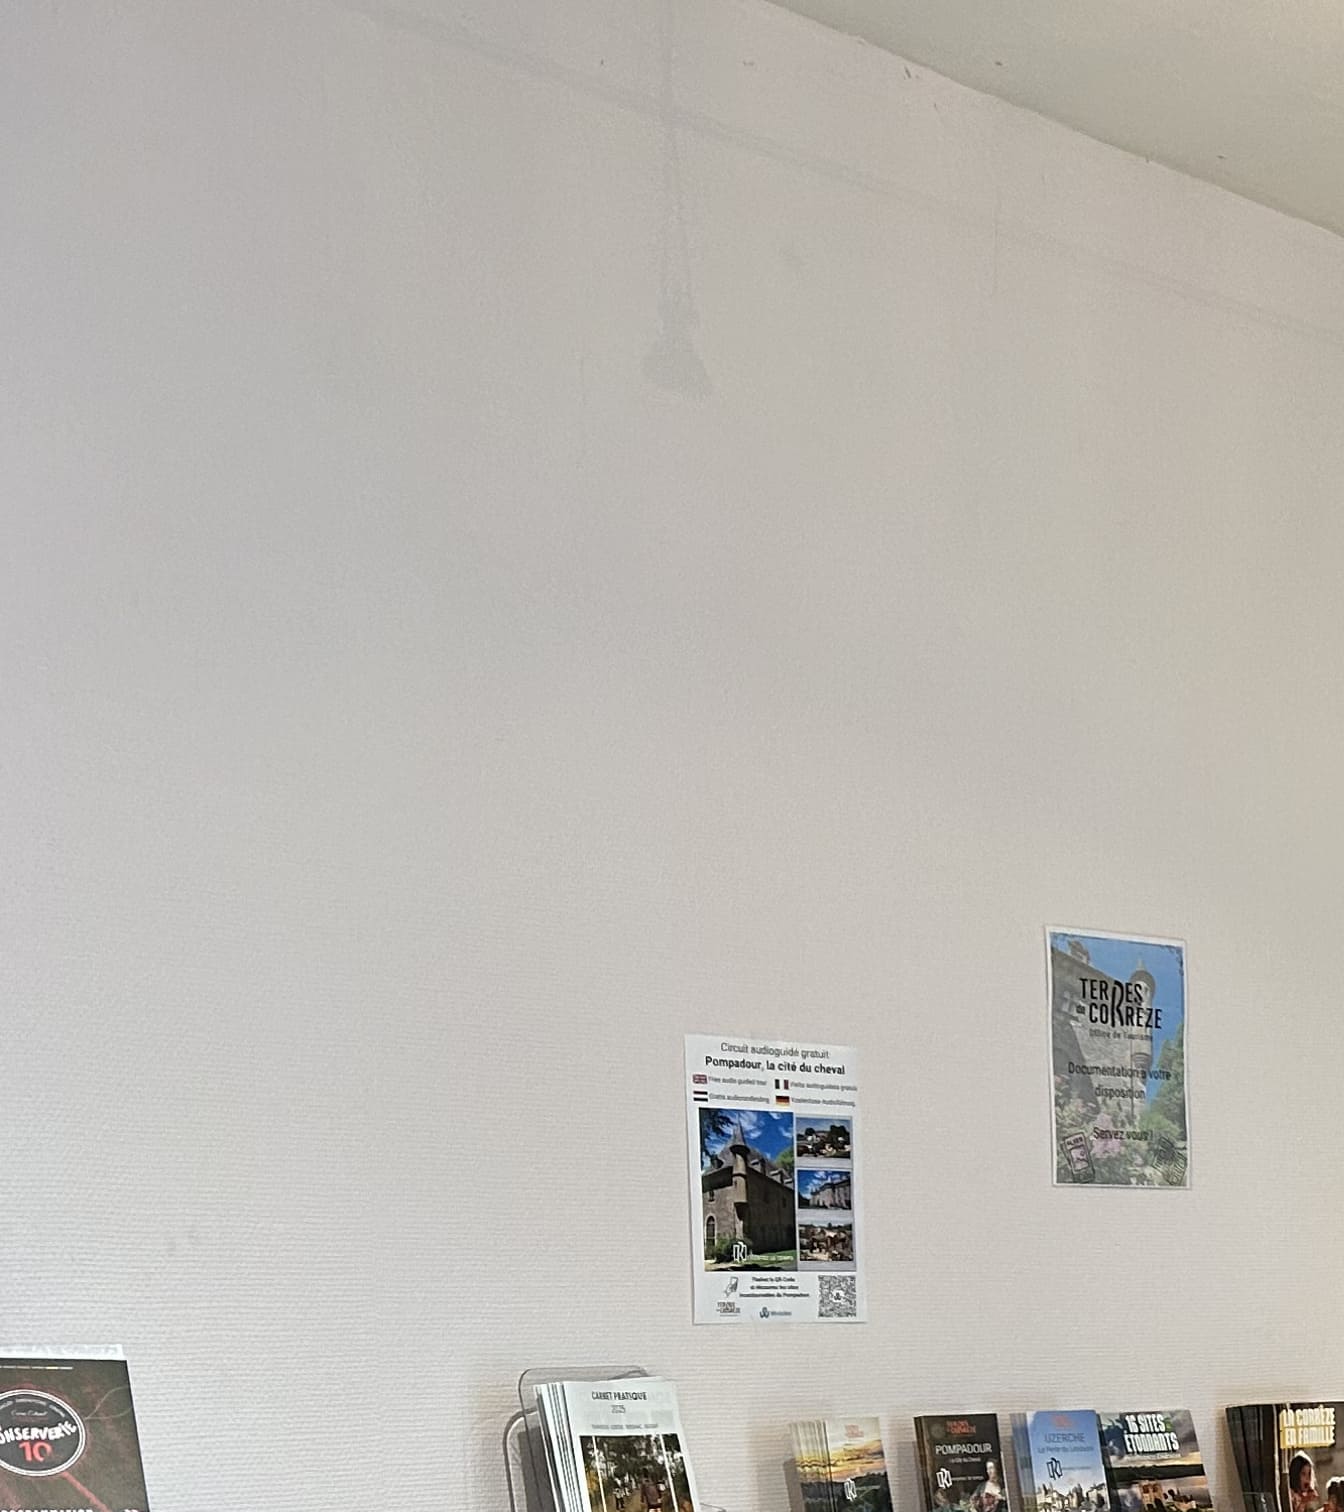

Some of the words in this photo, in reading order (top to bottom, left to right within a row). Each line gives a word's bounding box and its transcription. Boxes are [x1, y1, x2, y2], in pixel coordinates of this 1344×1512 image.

[721, 1043, 749, 1053] Circuit
[750, 1046, 799, 1058] audioguidé
[801, 1049, 829, 1059] gratuit
[705, 1056, 765, 1071] Pompadour,
[766, 1061, 775, 1070] la
[778, 1061, 797, 1072] cité
[800, 1062, 811, 1072] du
[814, 1064, 845, 1074] cheval
[1068, 1061, 1139, 1079] Documentation
[1149, 1069, 1171, 1081] votre
[1095, 1085, 1146, 1101] disposition
[614, 1392, 647, 1401] PRATIQUE
[1127, 1415, 1139, 1433] 16
[1140, 1414, 1166, 1433] SITES
[1280, 1408, 1295, 1427] LA
[1295, 1404, 1336, 1427] CORRÈZE
[0, 1420, 77, 1445] ONSERVERIE
[1044, 1432, 1086, 1443] UZERCHE
[1299, 1426, 1336, 1446] FAMILLE
[19, 1440, 53, 1462] 10
[935, 1443, 993, 1455] POMPADOUR
